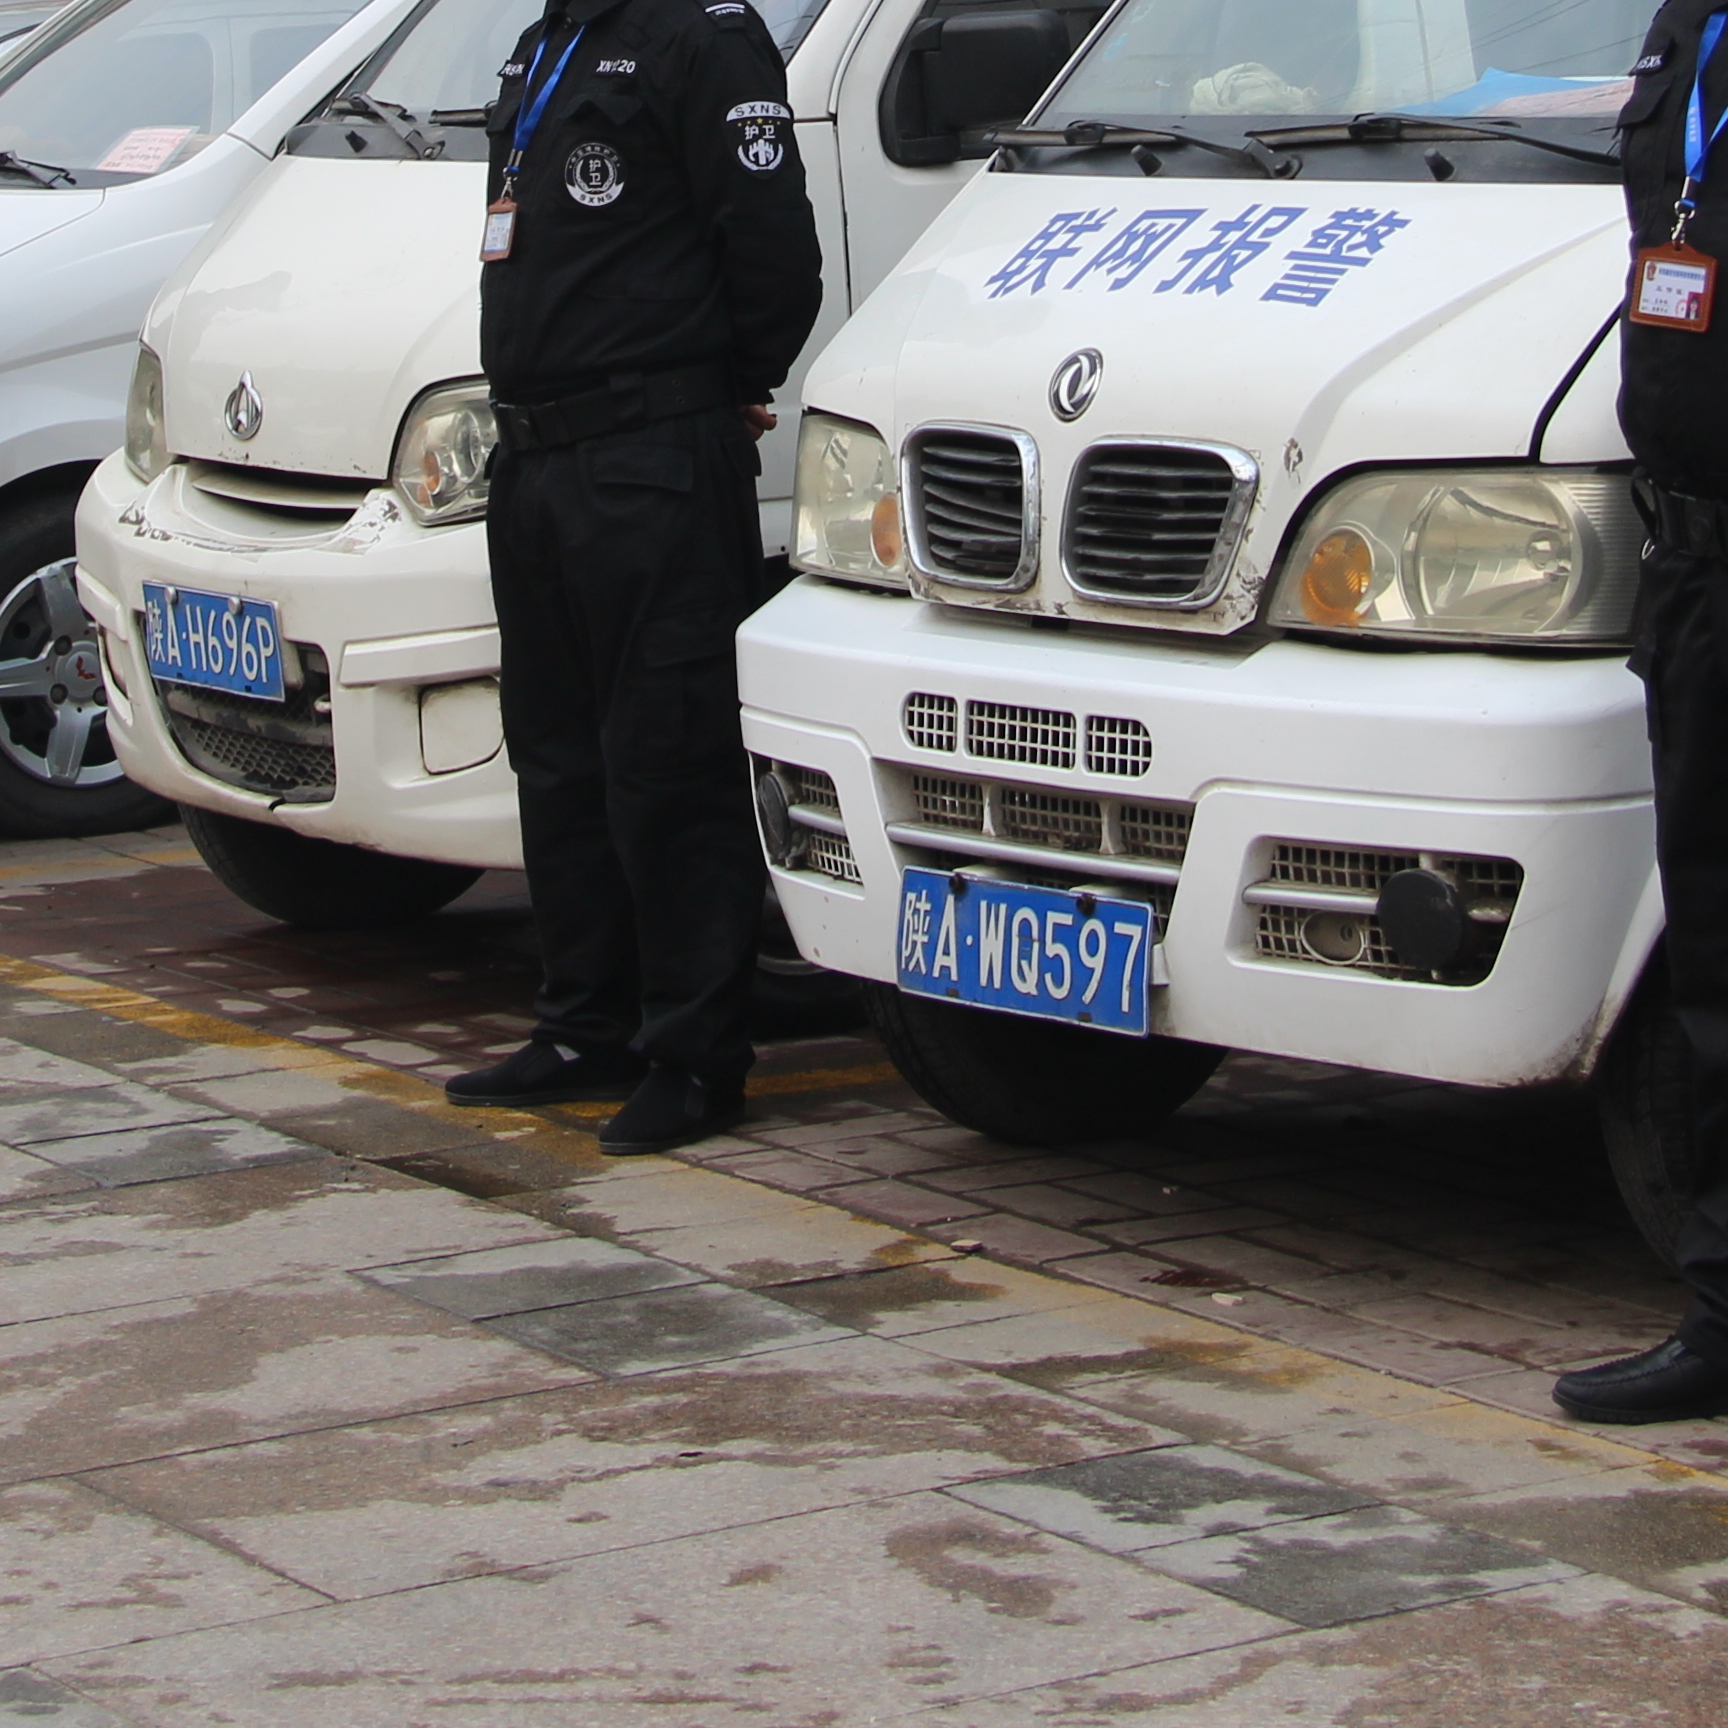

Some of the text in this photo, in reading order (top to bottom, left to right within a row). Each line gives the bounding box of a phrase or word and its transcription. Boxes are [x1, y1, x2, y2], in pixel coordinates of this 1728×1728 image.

[734, 103, 783, 117] SXNS
[744, 124, 776, 140] 护卫
[589, 158, 602, 186] 护卫
[983, 203, 1412, 308] 联网报警
